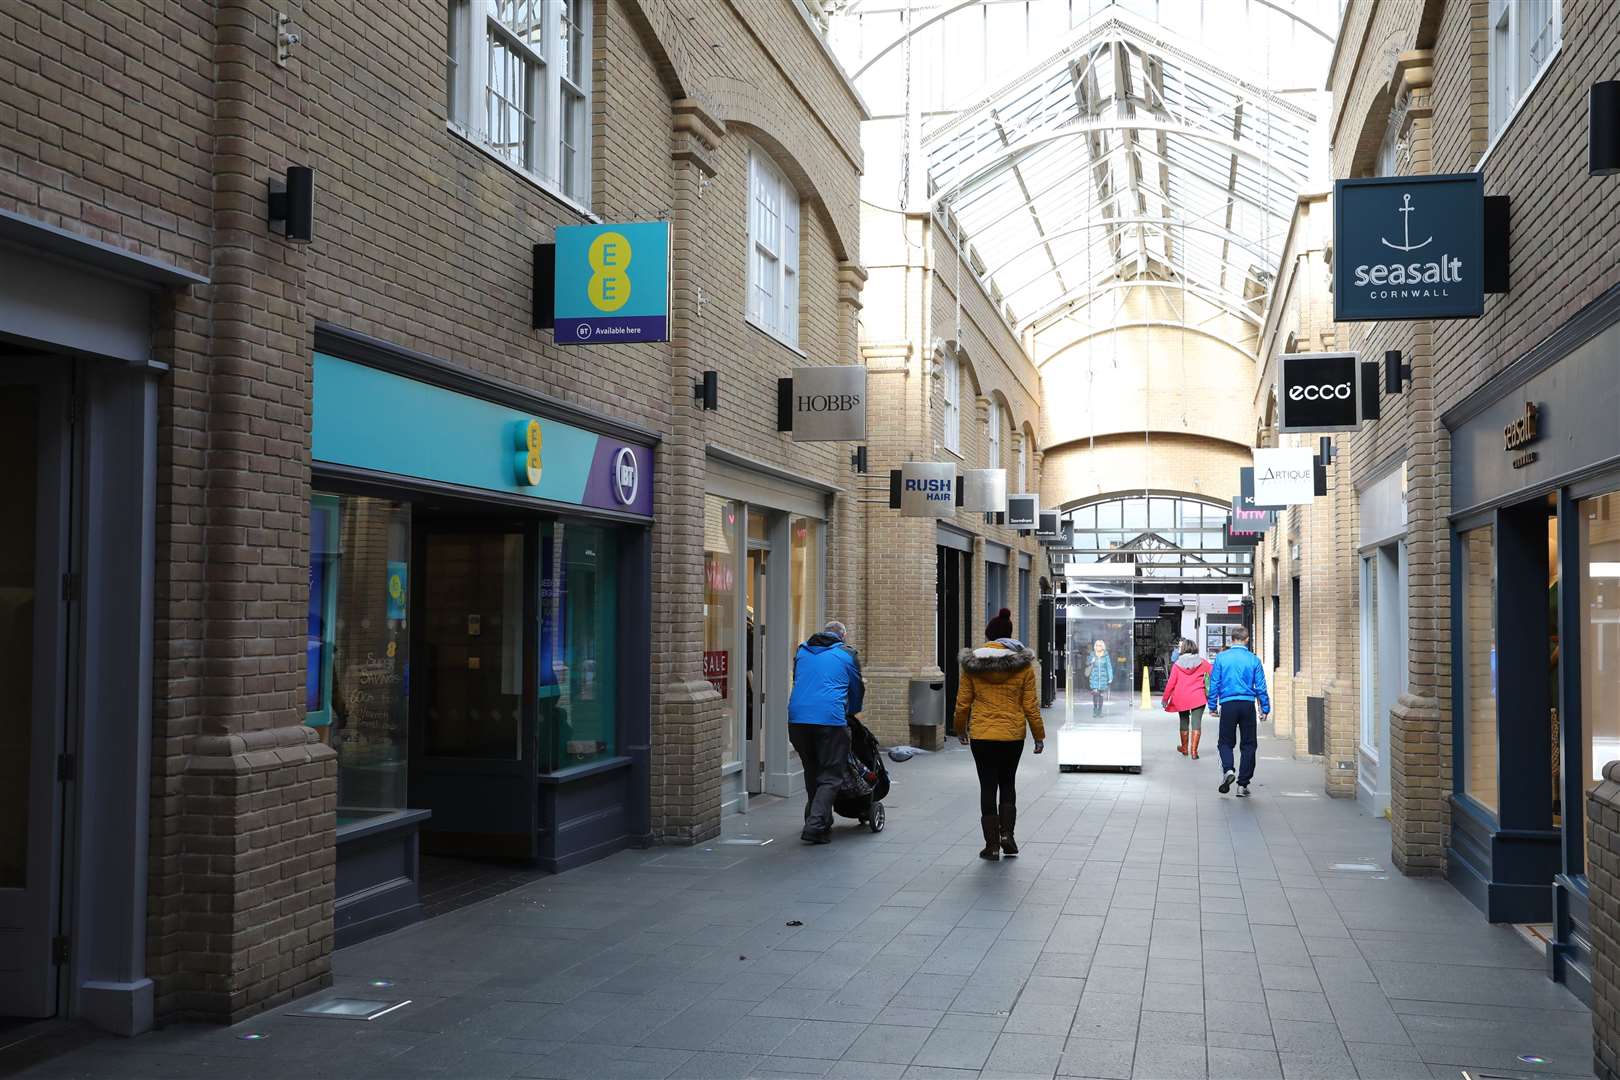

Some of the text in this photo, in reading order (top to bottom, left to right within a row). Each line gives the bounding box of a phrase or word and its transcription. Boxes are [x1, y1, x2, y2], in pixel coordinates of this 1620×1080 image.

[1354, 253, 1463, 287] seasalt
[1370, 288, 1449, 300] CORNWALL
[595, 326, 625, 335] Available
[626, 325, 641, 334] here
[1288, 381, 1351, 401] ecco
[797, 393, 860, 412] HOBBS
[620, 464, 634, 488] BT
[1258, 467, 1311, 483] ARTIQUE
[905, 478, 951, 493] RUSH
[926, 492, 951, 502] HAIR
[1236, 506, 1266, 520] hmv
[703, 655, 726, 673] SALE
